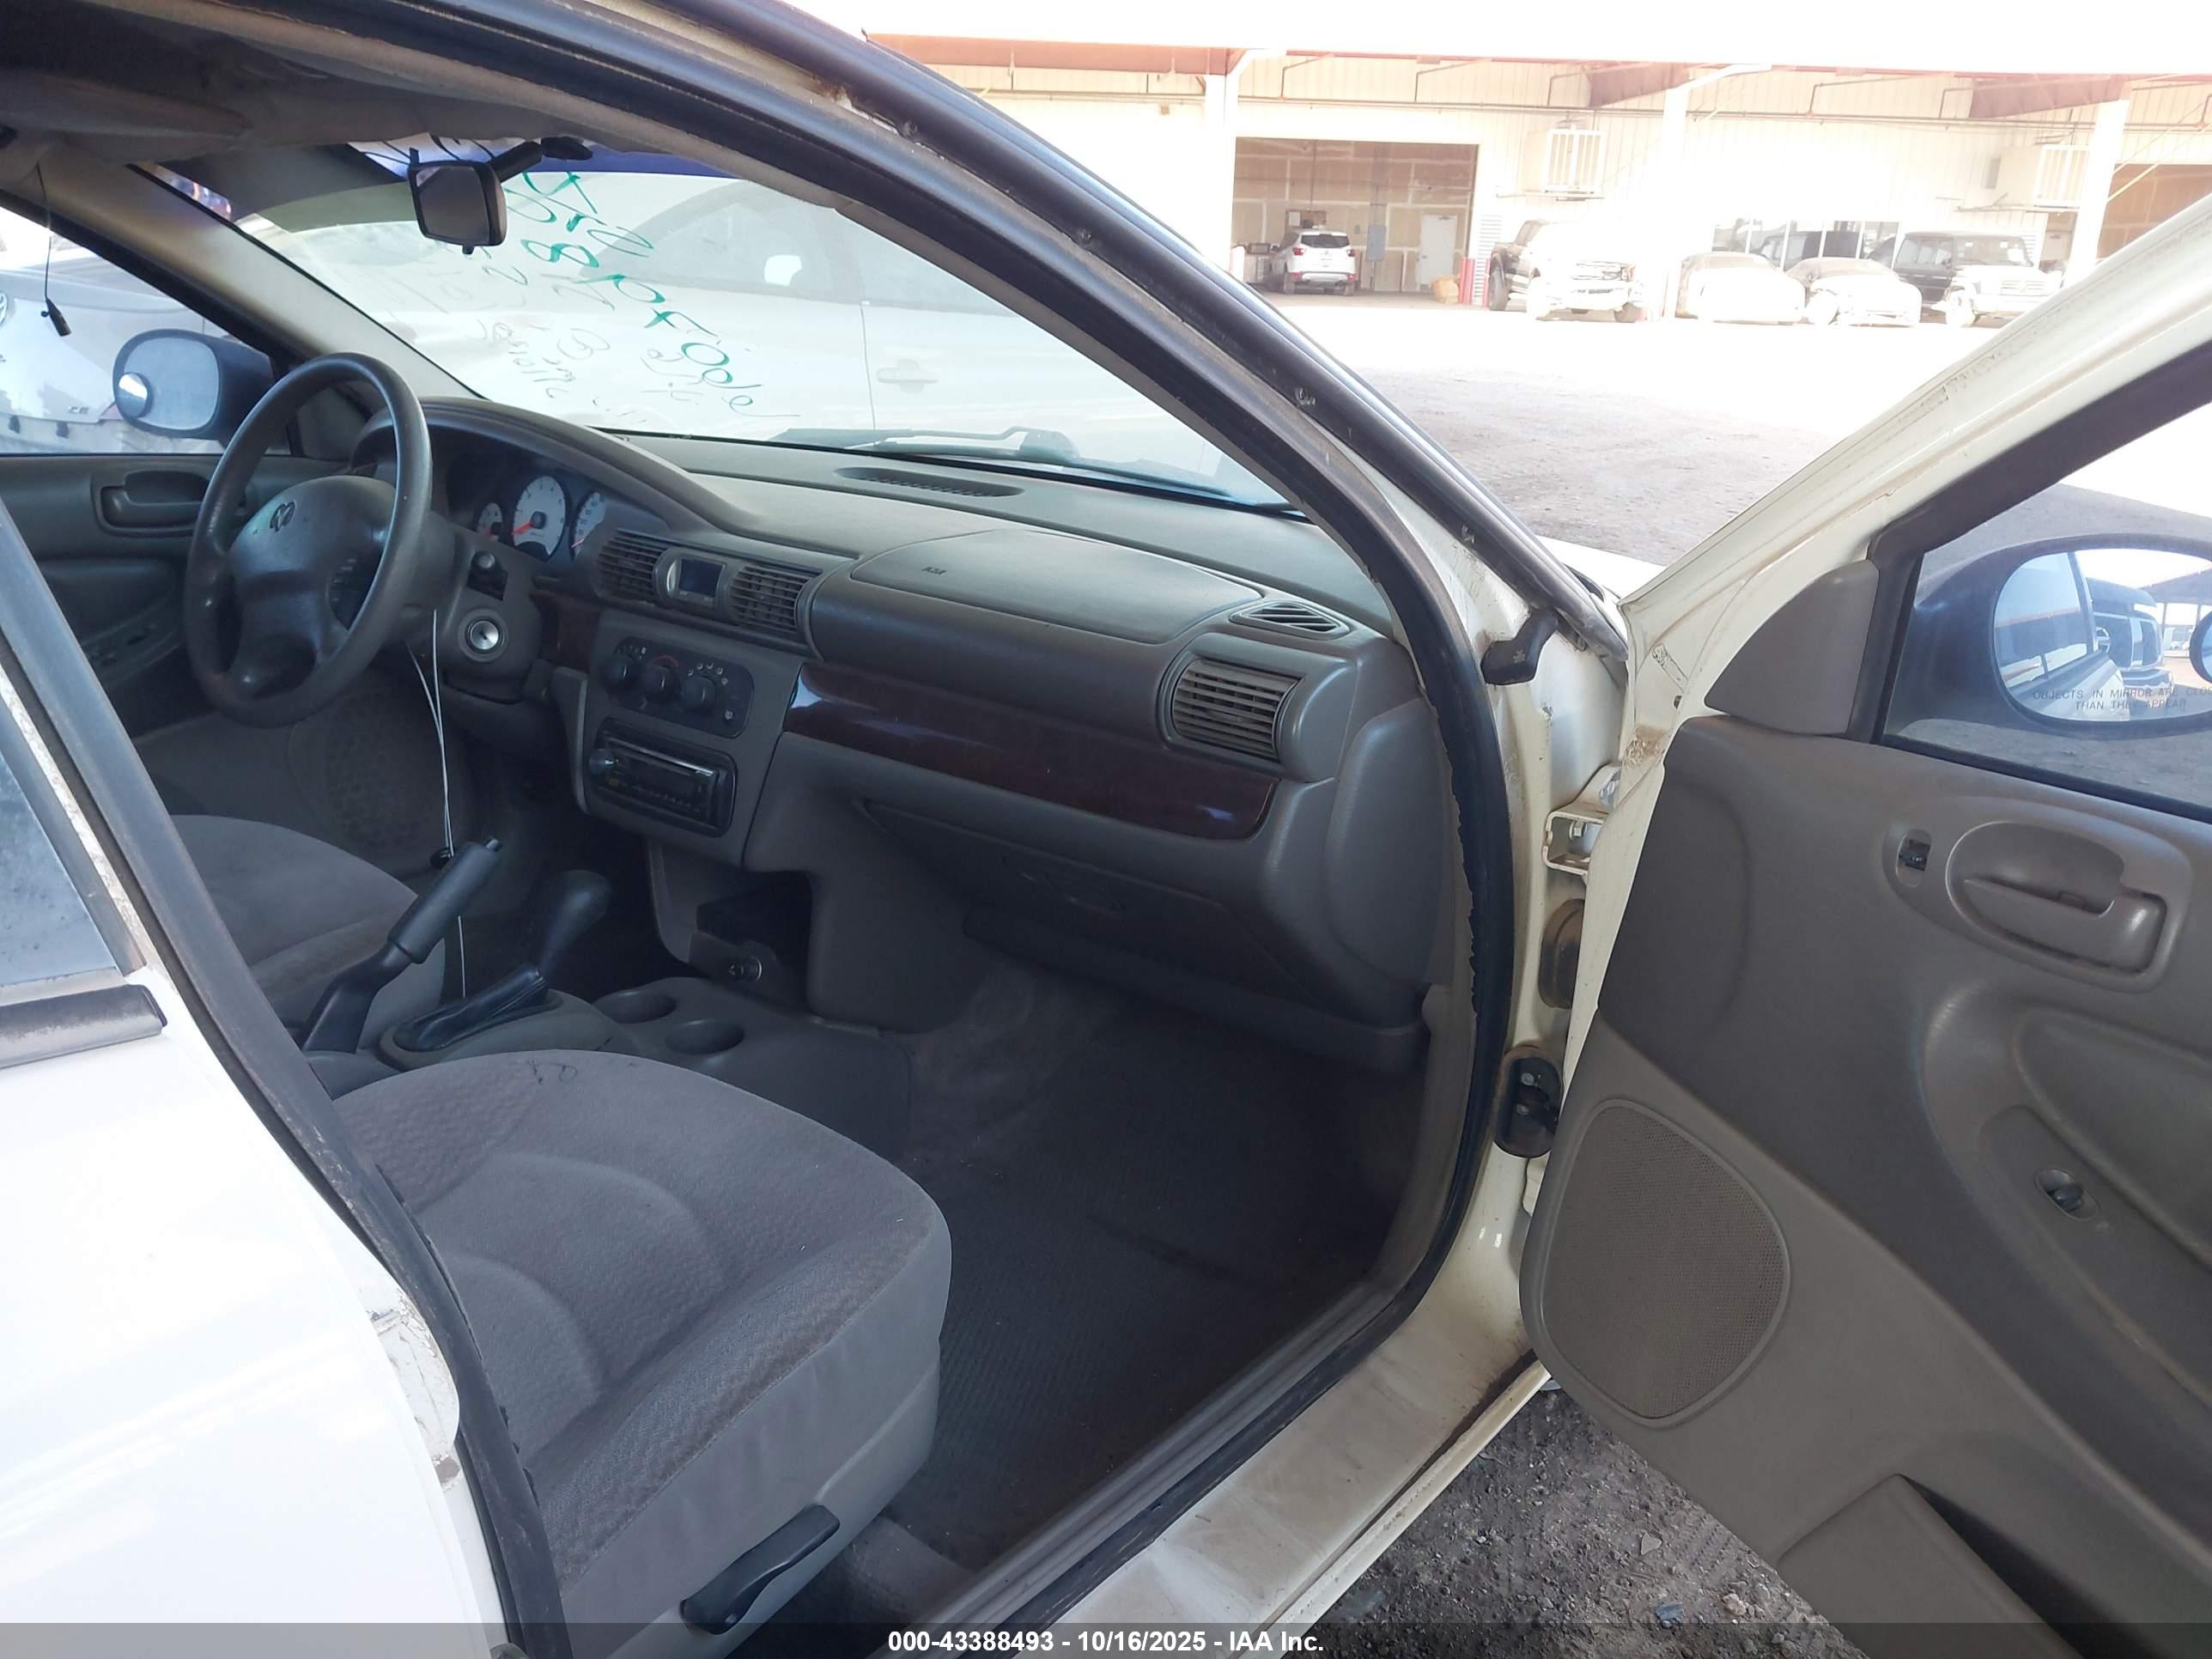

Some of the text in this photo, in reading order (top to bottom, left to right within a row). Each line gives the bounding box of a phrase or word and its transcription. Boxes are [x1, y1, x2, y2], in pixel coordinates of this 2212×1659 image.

[2033, 690, 2083, 700] OBJECTS
[2093, 690, 2103, 698] IN
[2110, 689, 2153, 698] MIRROR
[2158, 688, 2179, 697] ARE
[2075, 701, 2104, 710] THAN
[2145, 698, 2187, 708] APPEAR
